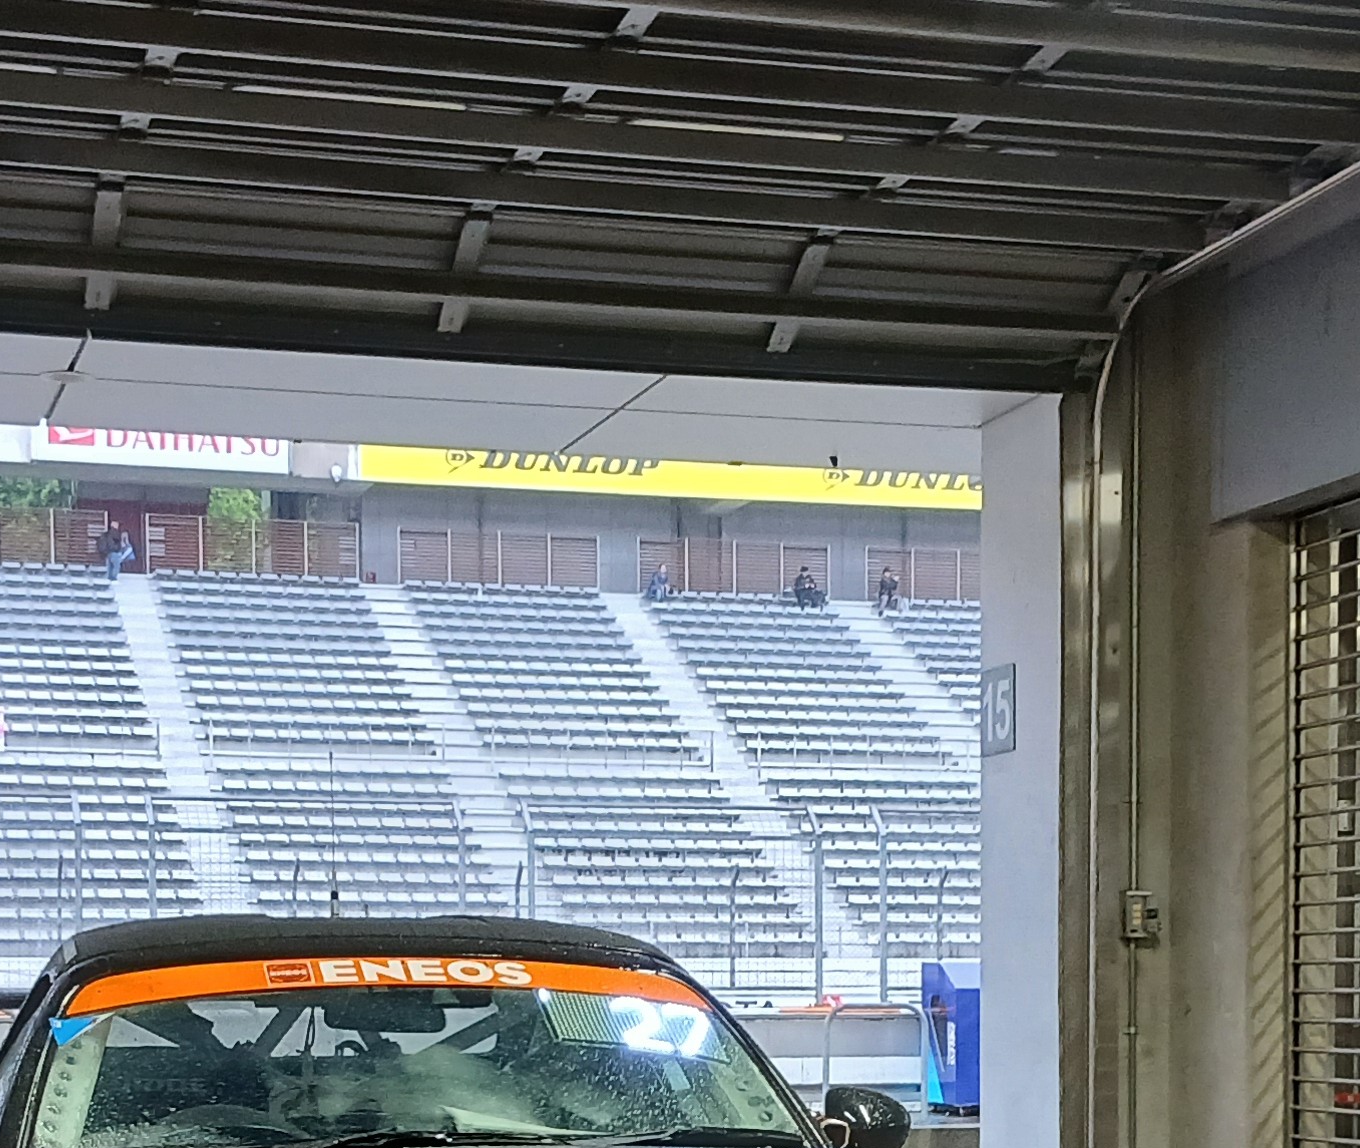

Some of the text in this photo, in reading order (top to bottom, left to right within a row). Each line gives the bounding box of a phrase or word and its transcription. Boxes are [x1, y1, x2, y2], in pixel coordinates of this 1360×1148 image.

[105, 428, 281, 457] DAIHATSU
[479, 450, 660, 477] DUNLOP
[982, 678, 1011, 742] 15
[318, 959, 533, 986] ENEOS
[608, 996, 711, 1057] 27
